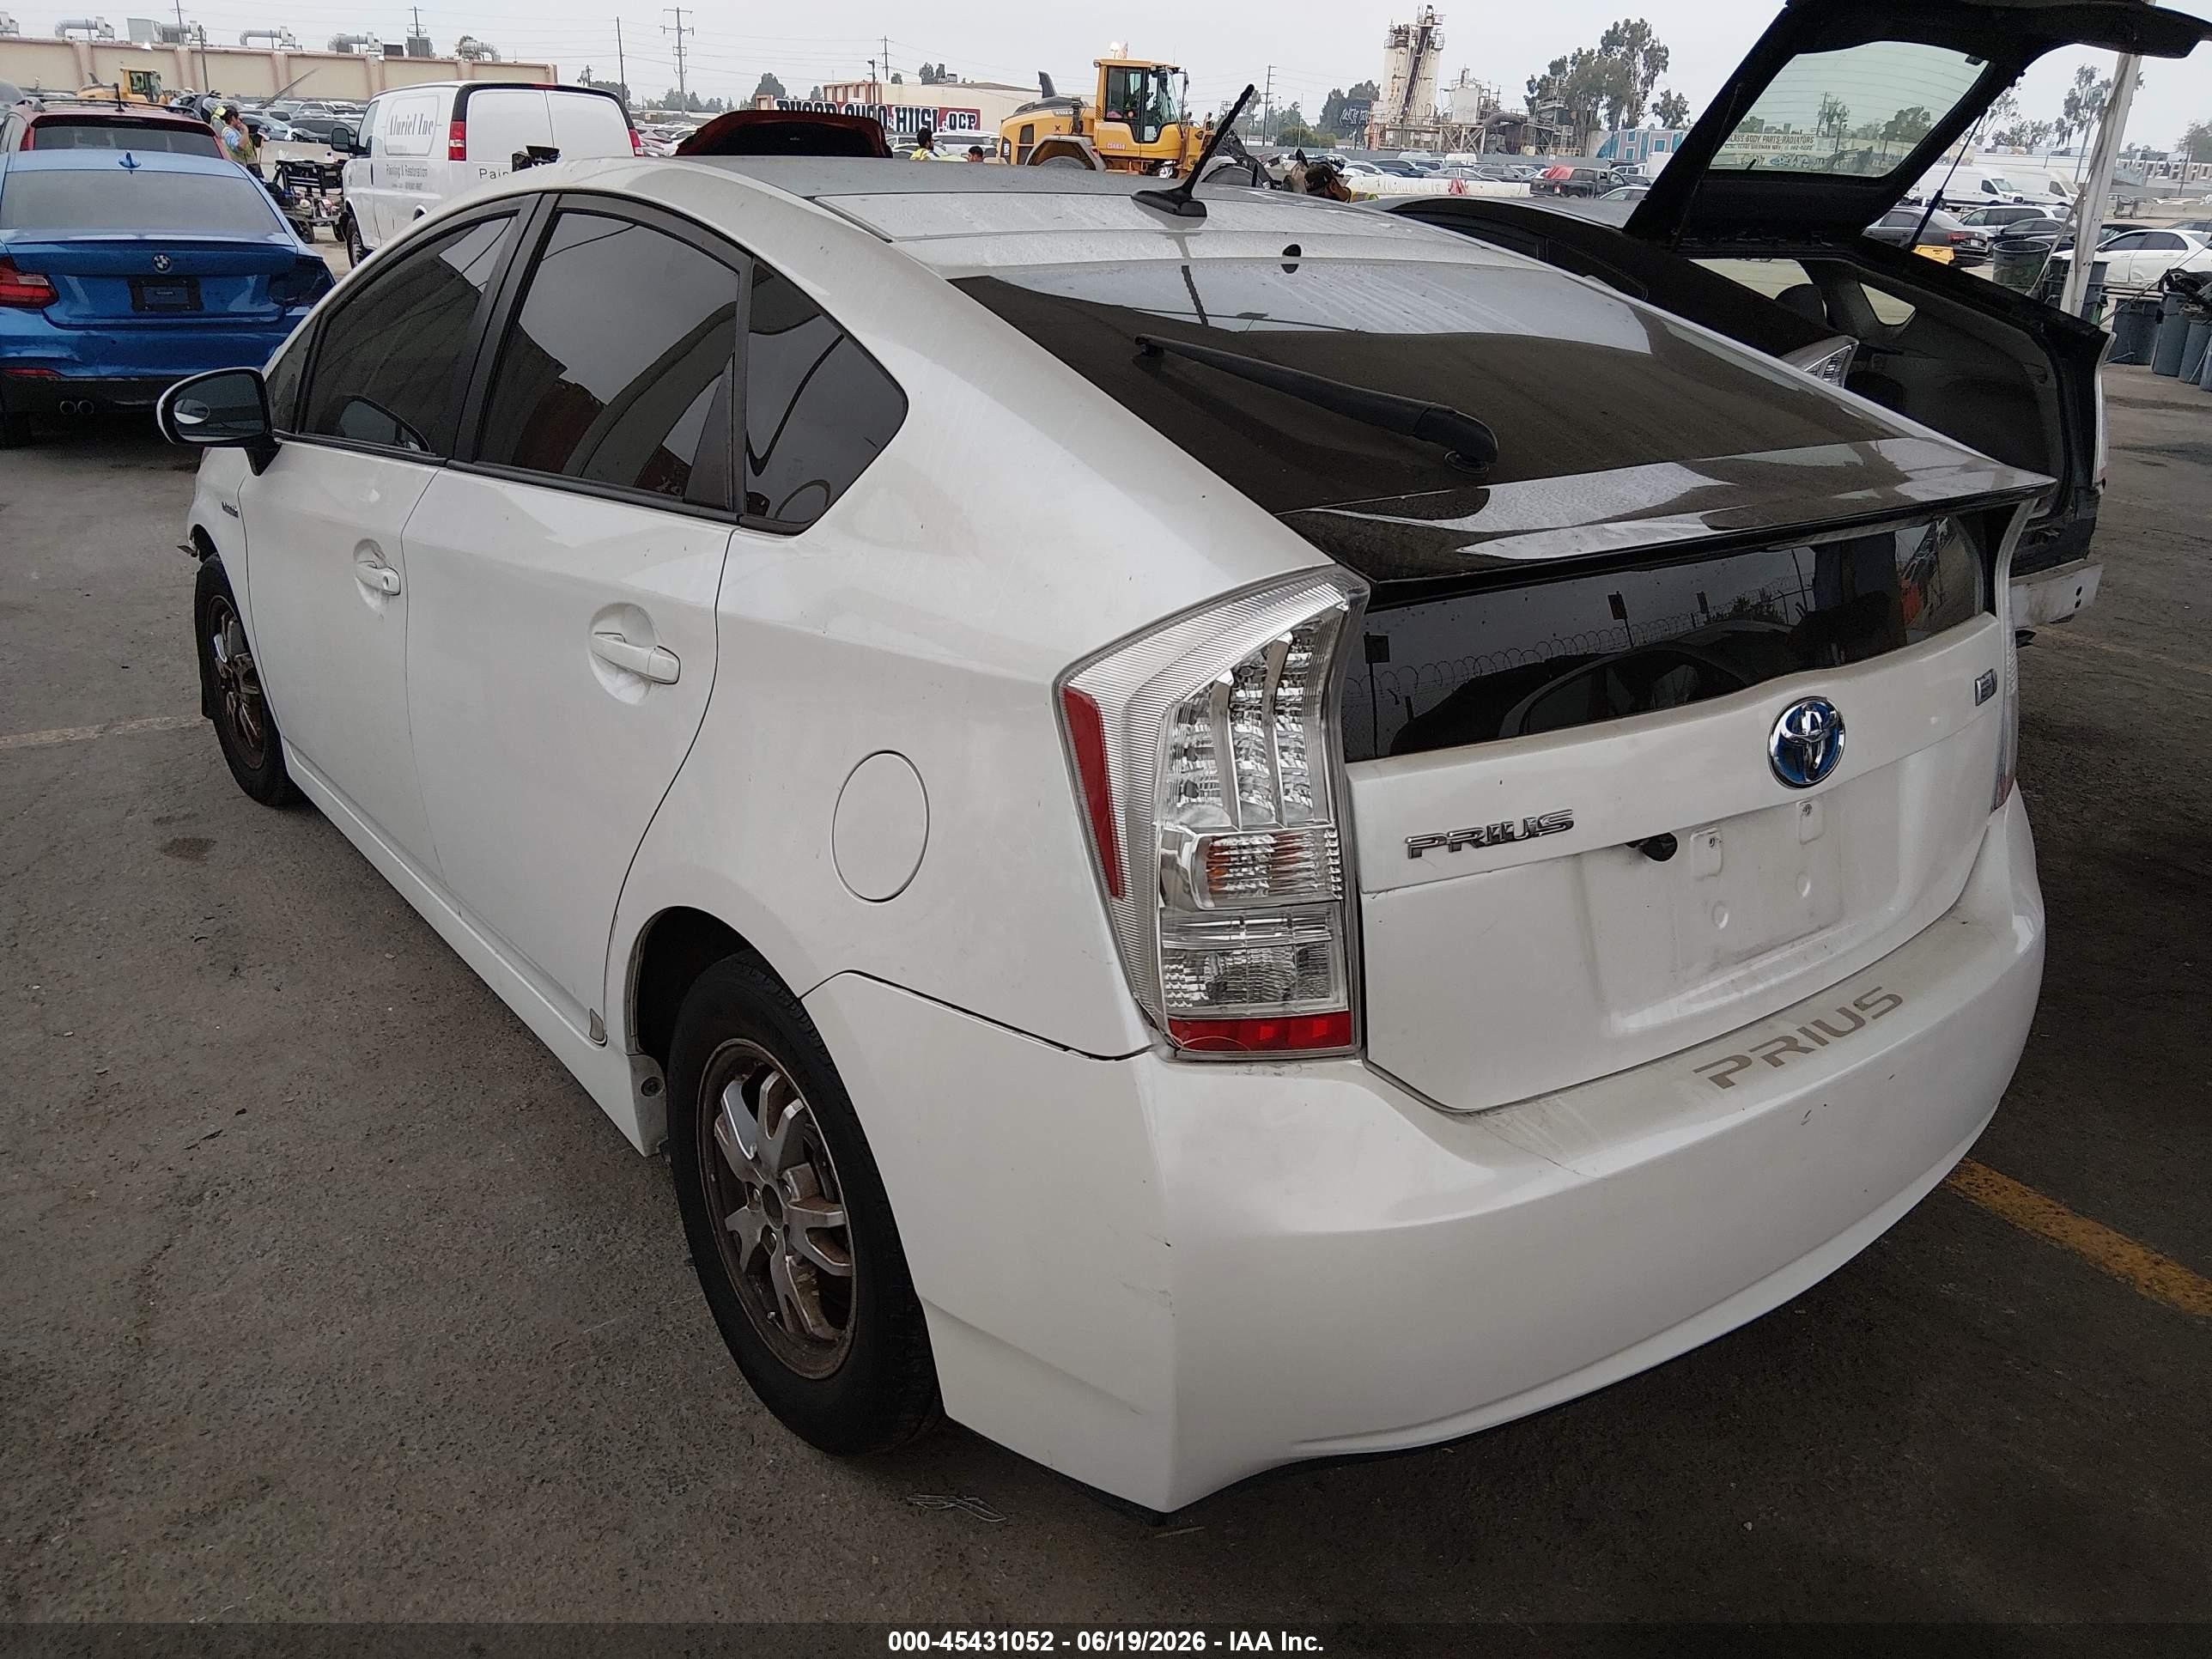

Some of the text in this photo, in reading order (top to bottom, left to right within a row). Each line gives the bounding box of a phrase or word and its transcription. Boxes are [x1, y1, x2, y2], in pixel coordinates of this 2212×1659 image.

[418, 113, 434, 136] Inc
[1405, 808, 1575, 860] PRIUS
[1692, 987, 1904, 1090] PRIUS
